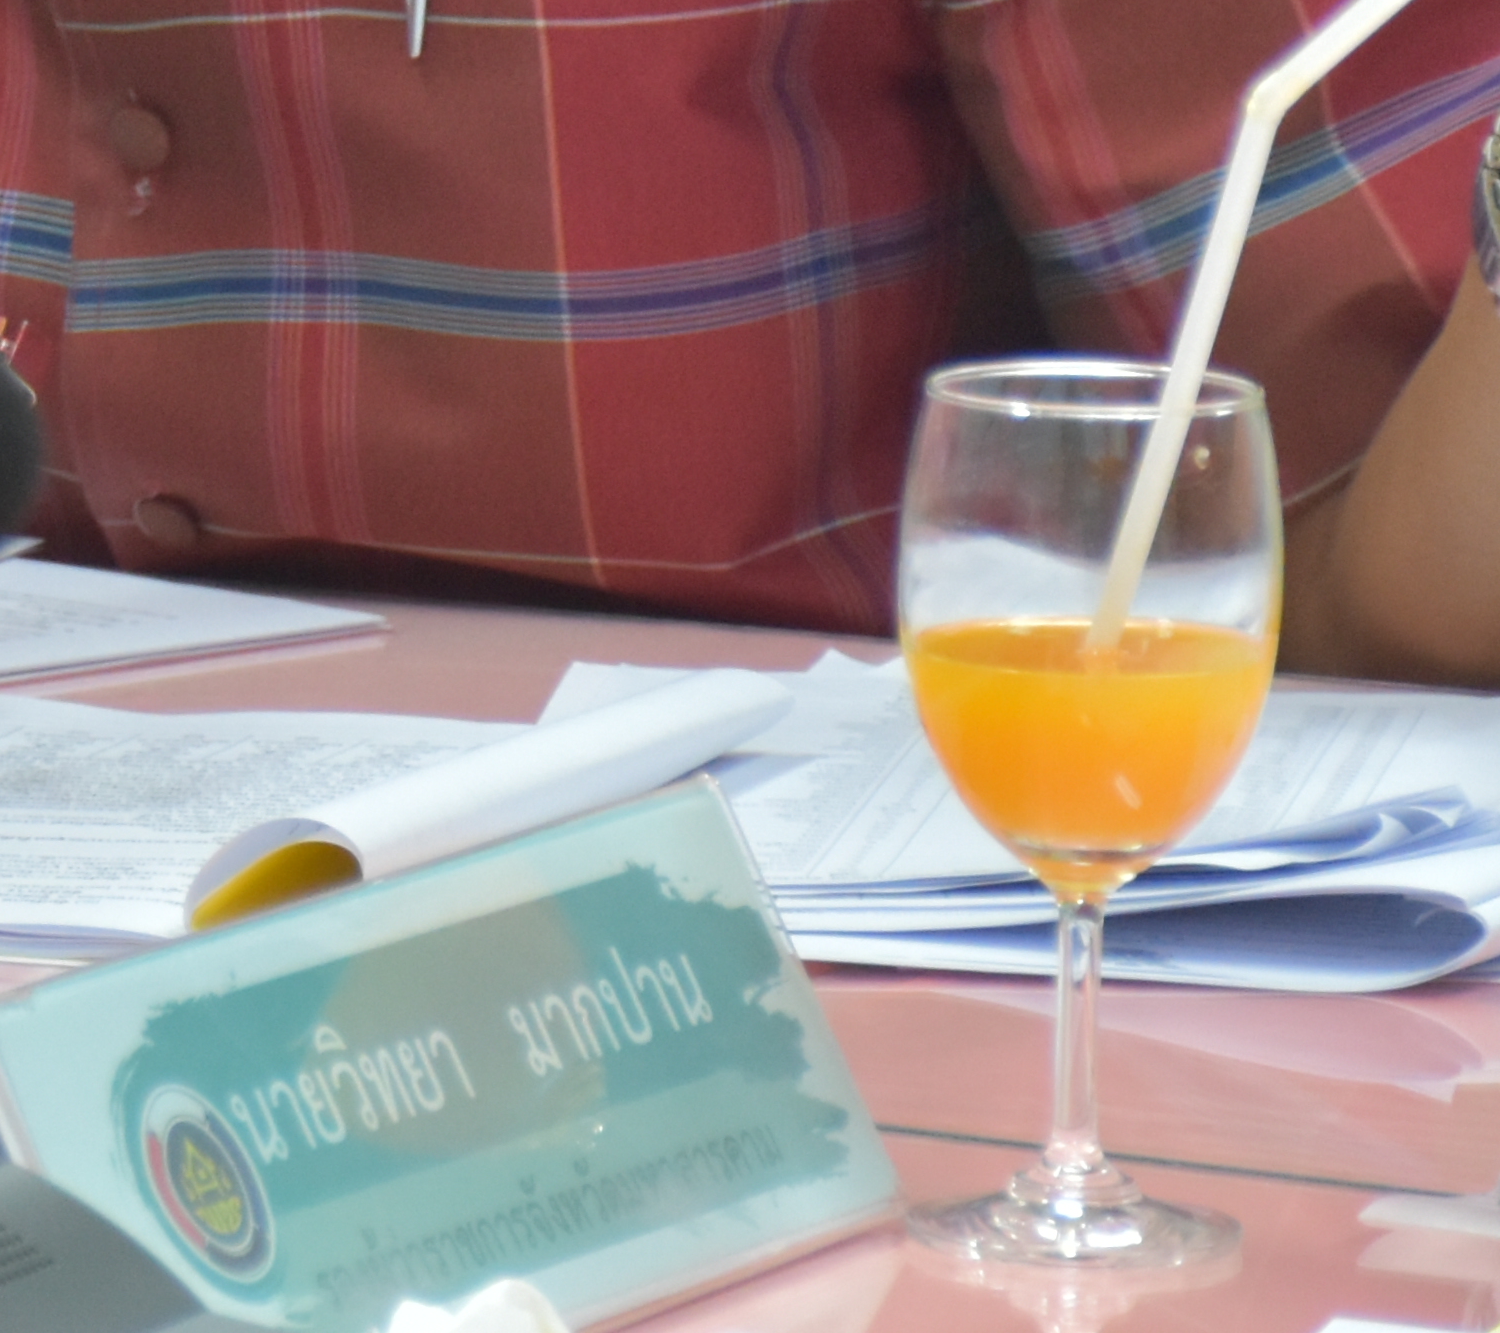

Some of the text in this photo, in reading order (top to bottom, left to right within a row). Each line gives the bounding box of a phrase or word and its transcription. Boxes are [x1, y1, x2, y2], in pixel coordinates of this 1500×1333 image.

[229, 945, 713, 1165] นายวิทยา มากปาน
